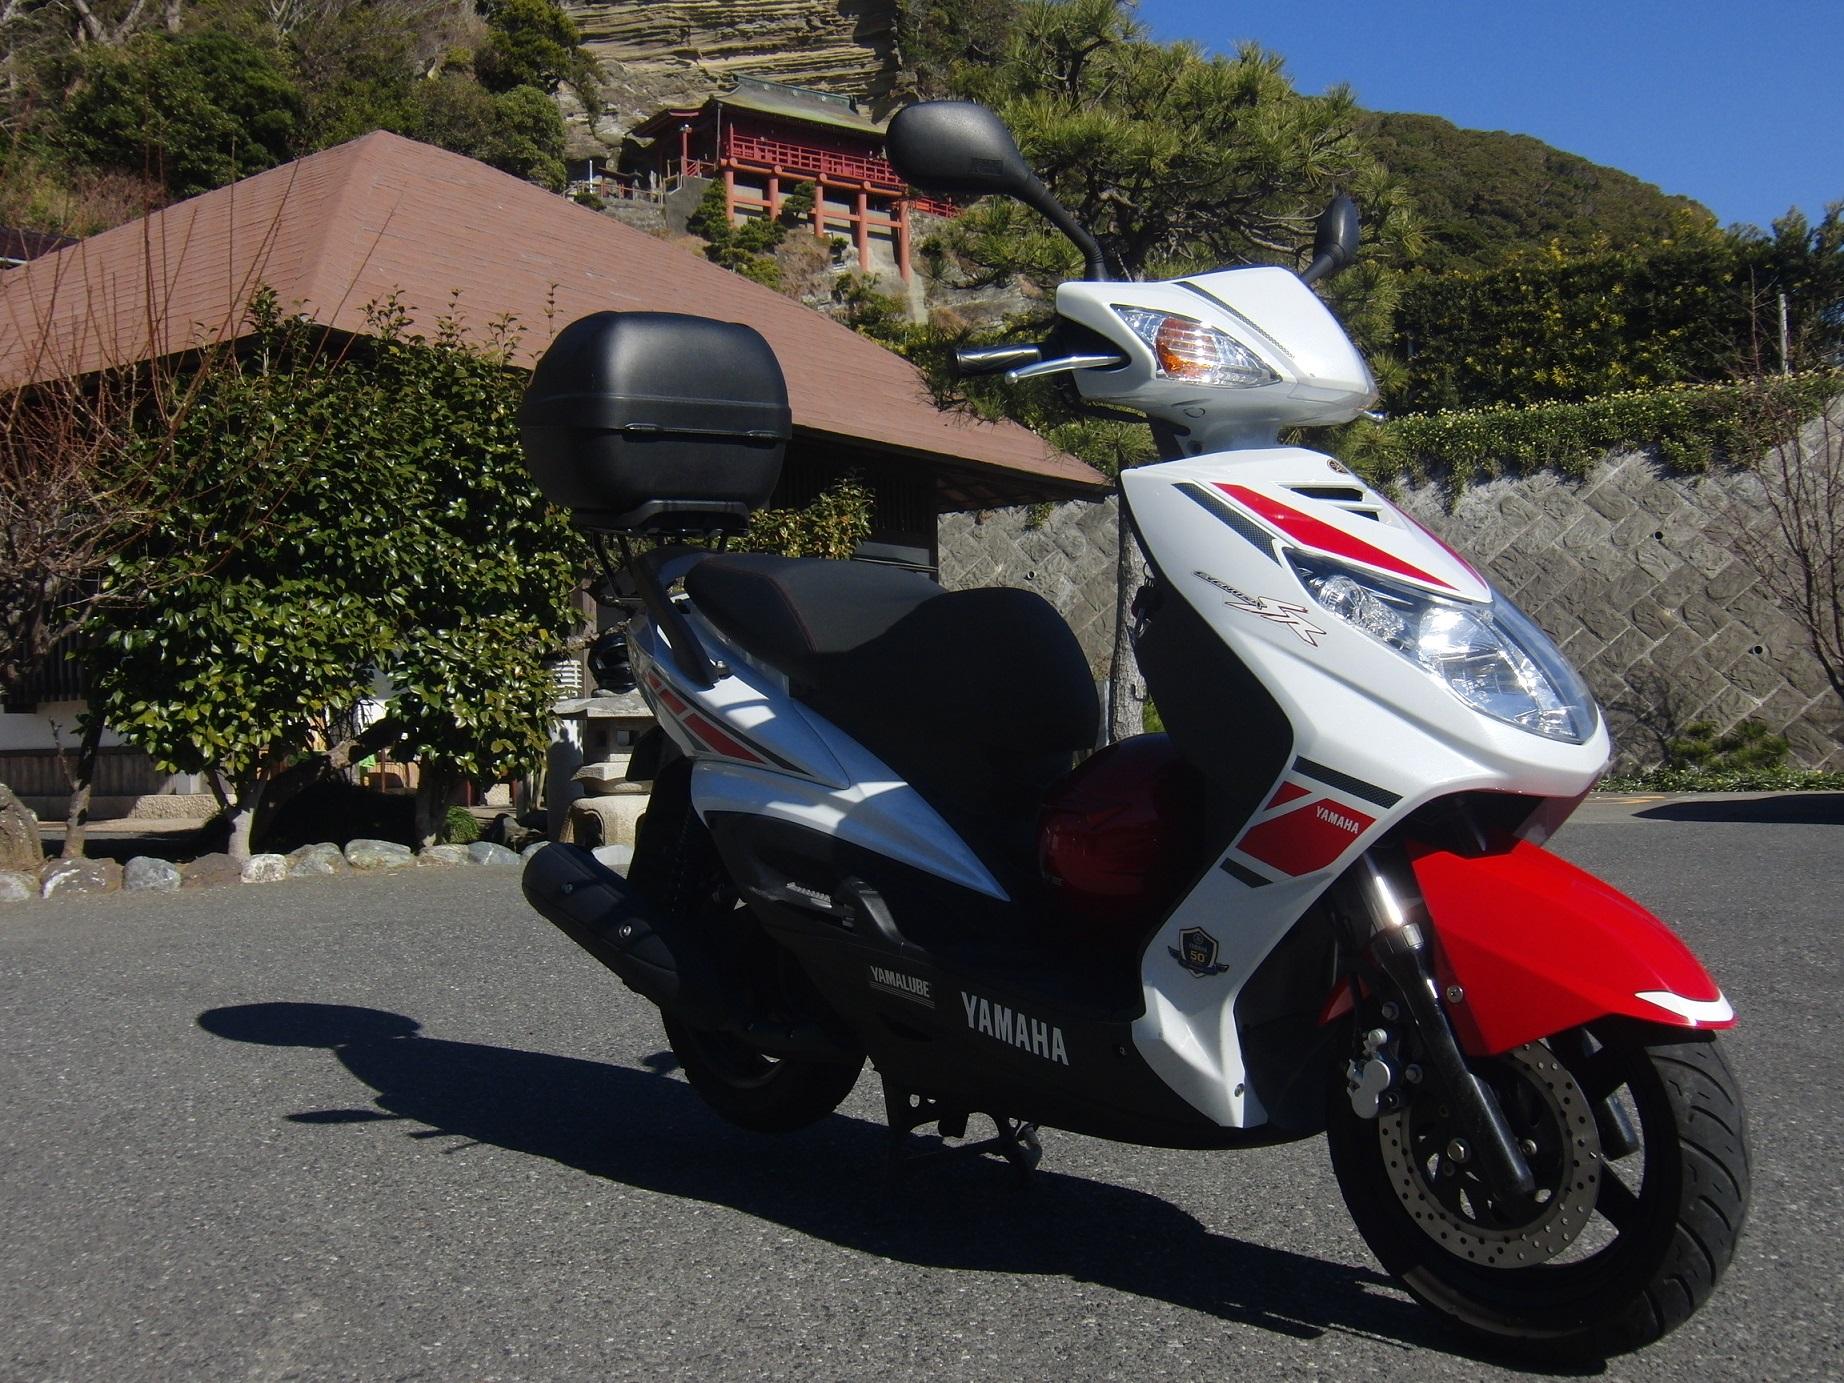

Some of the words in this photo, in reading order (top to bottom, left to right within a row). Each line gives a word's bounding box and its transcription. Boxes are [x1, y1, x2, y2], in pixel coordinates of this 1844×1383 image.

[1315, 805, 1359, 834] YAMAHA
[1190, 950, 1206, 963] 50
[870, 965, 931, 998] YAMALUBE
[961, 991, 1070, 1066] YAMAHA
